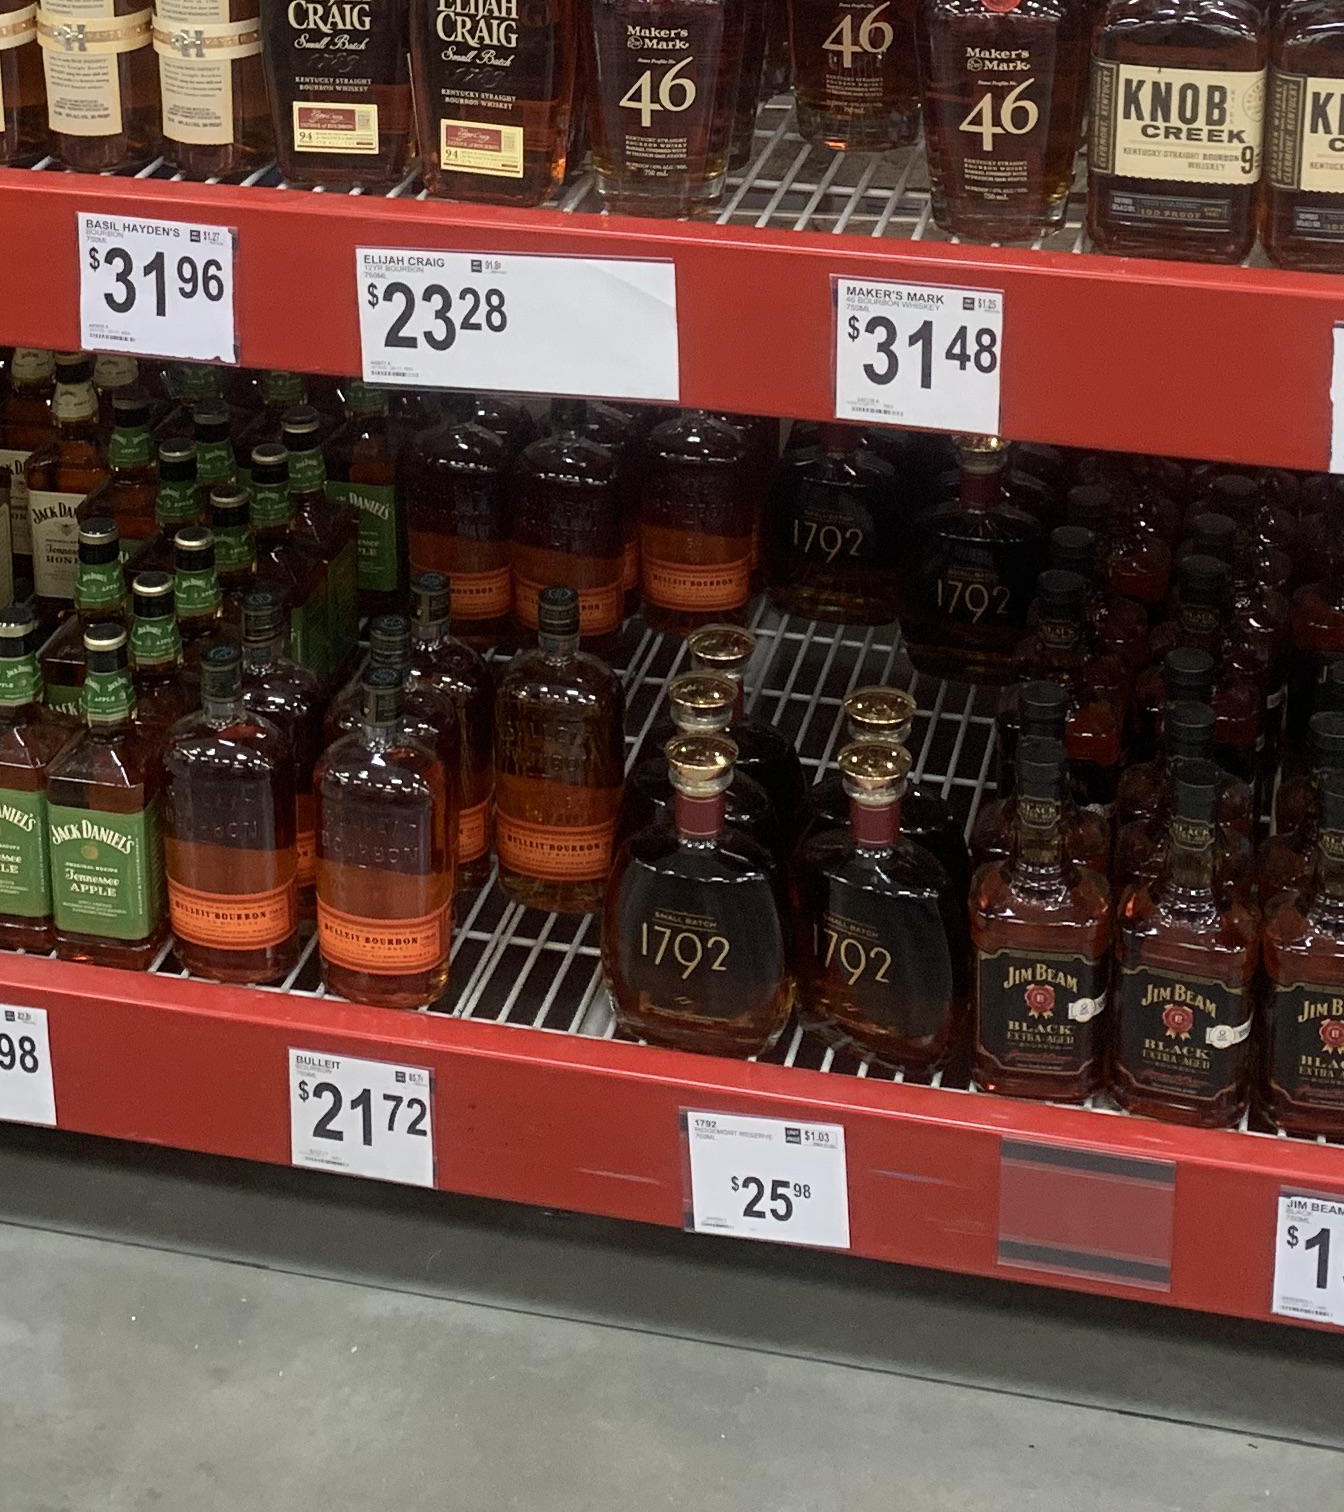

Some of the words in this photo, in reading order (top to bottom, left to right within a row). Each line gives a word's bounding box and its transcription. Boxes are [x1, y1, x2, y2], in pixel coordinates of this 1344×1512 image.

[288, 0, 371, 33] CRAIG
[437, 12, 518, 47] CRAIG
[627, 24, 688, 37] Maker's
[822, 1, 894, 67] 46
[643, 39, 689, 49] Mark
[966, 47, 1029, 59] Maker's
[984, 60, 1030, 70] Mark
[619, 56, 696, 127] 46
[1123, 78, 1227, 126] KNOB
[1141, 124, 1246, 144] CREEK
[86, 220, 119, 232] BASIL
[123, 223, 180, 238] HAYDEN'S
[364, 255, 404, 265] ELIJAH
[408, 257, 445, 267] CRAIG
[846, 286, 903, 301] MAKER'S
[907, 292, 944, 304] MARK
[71, 883, 117, 896] APPLE
[215, 911, 267, 920] BOURBON
[642, 922, 730, 979] 1792
[1004, 966, 1033, 988] JIM
[1036, 963, 1077, 993] BEAM
[1008, 1021, 1071, 1034] BLACK
[296, 1056, 341, 1069] BULLEIT
[695, 1119, 716, 1128] 1792
[805, 1131, 829, 1143] $1.03
[1287, 1200, 1308, 1211] JIM
